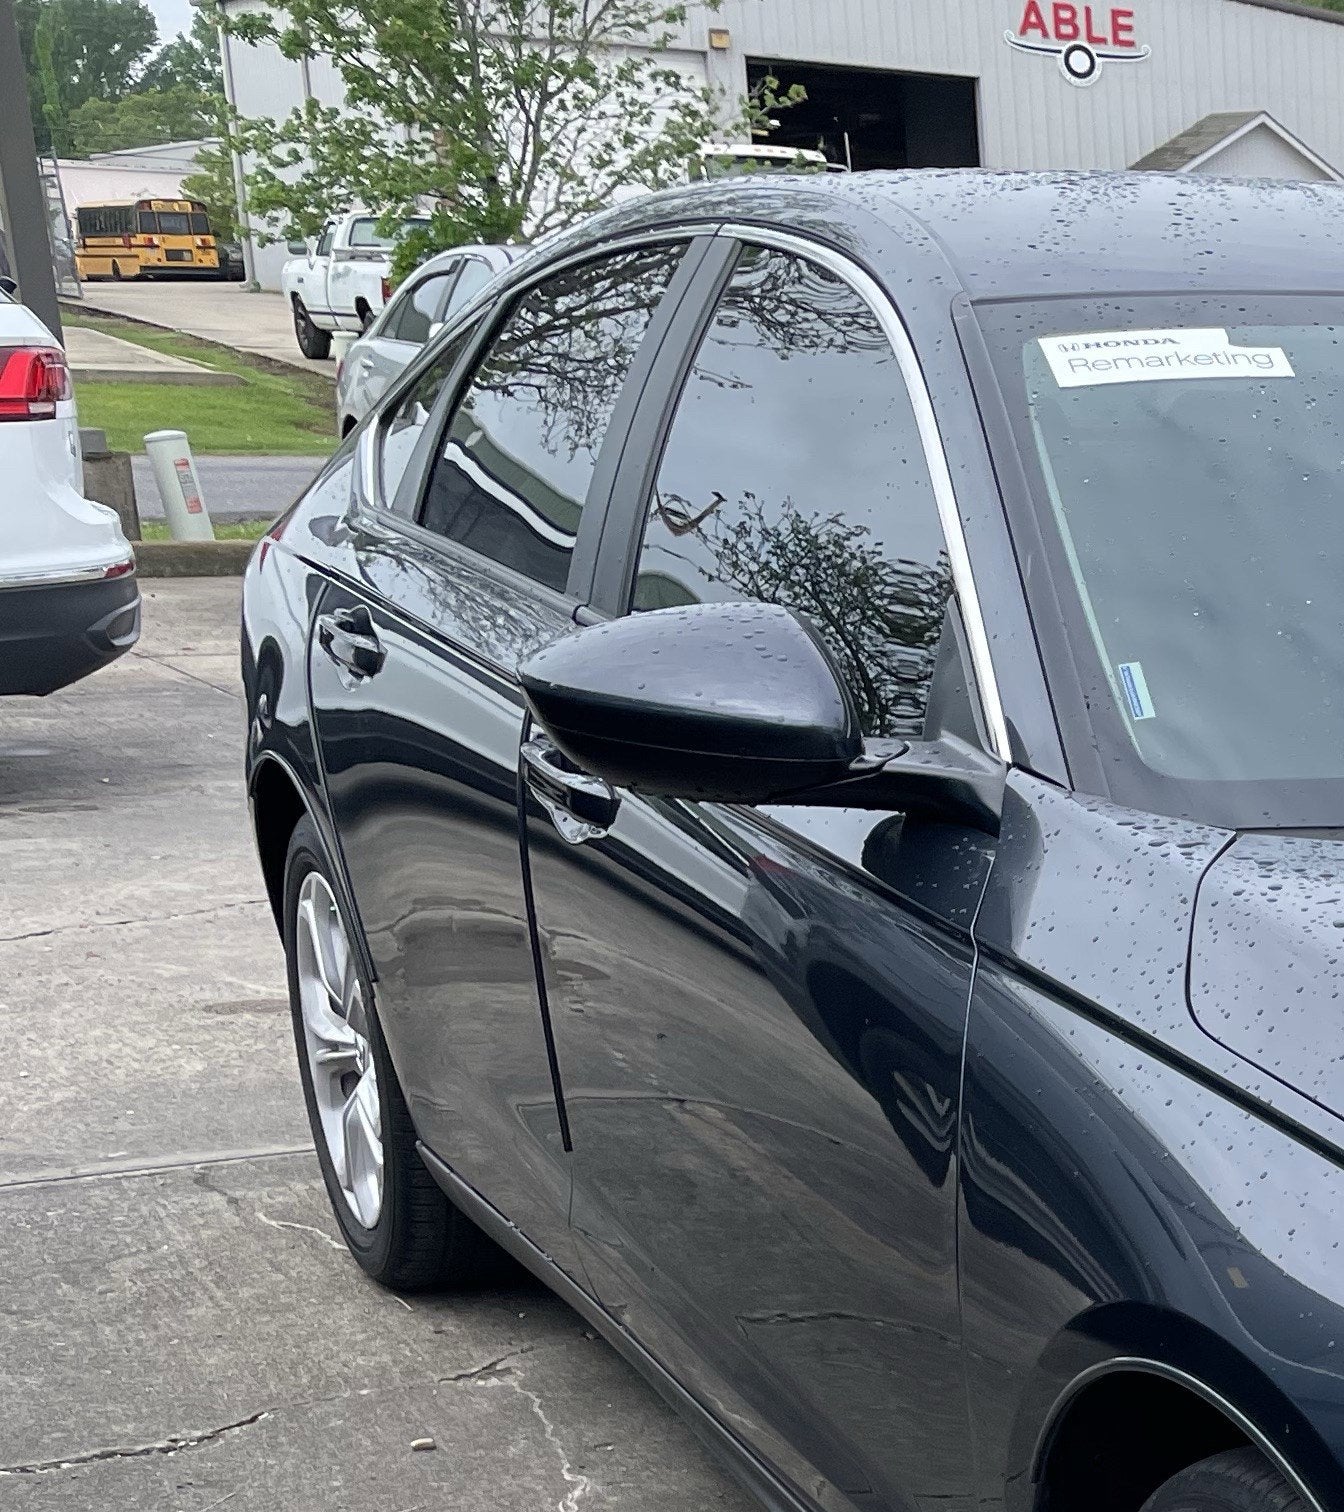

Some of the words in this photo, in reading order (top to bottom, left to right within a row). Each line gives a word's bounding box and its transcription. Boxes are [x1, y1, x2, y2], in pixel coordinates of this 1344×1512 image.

[1019, 0, 1135, 47] ABLE
[1083, 337, 1181, 350] HONDA
[1067, 350, 1274, 373] Remarketing
